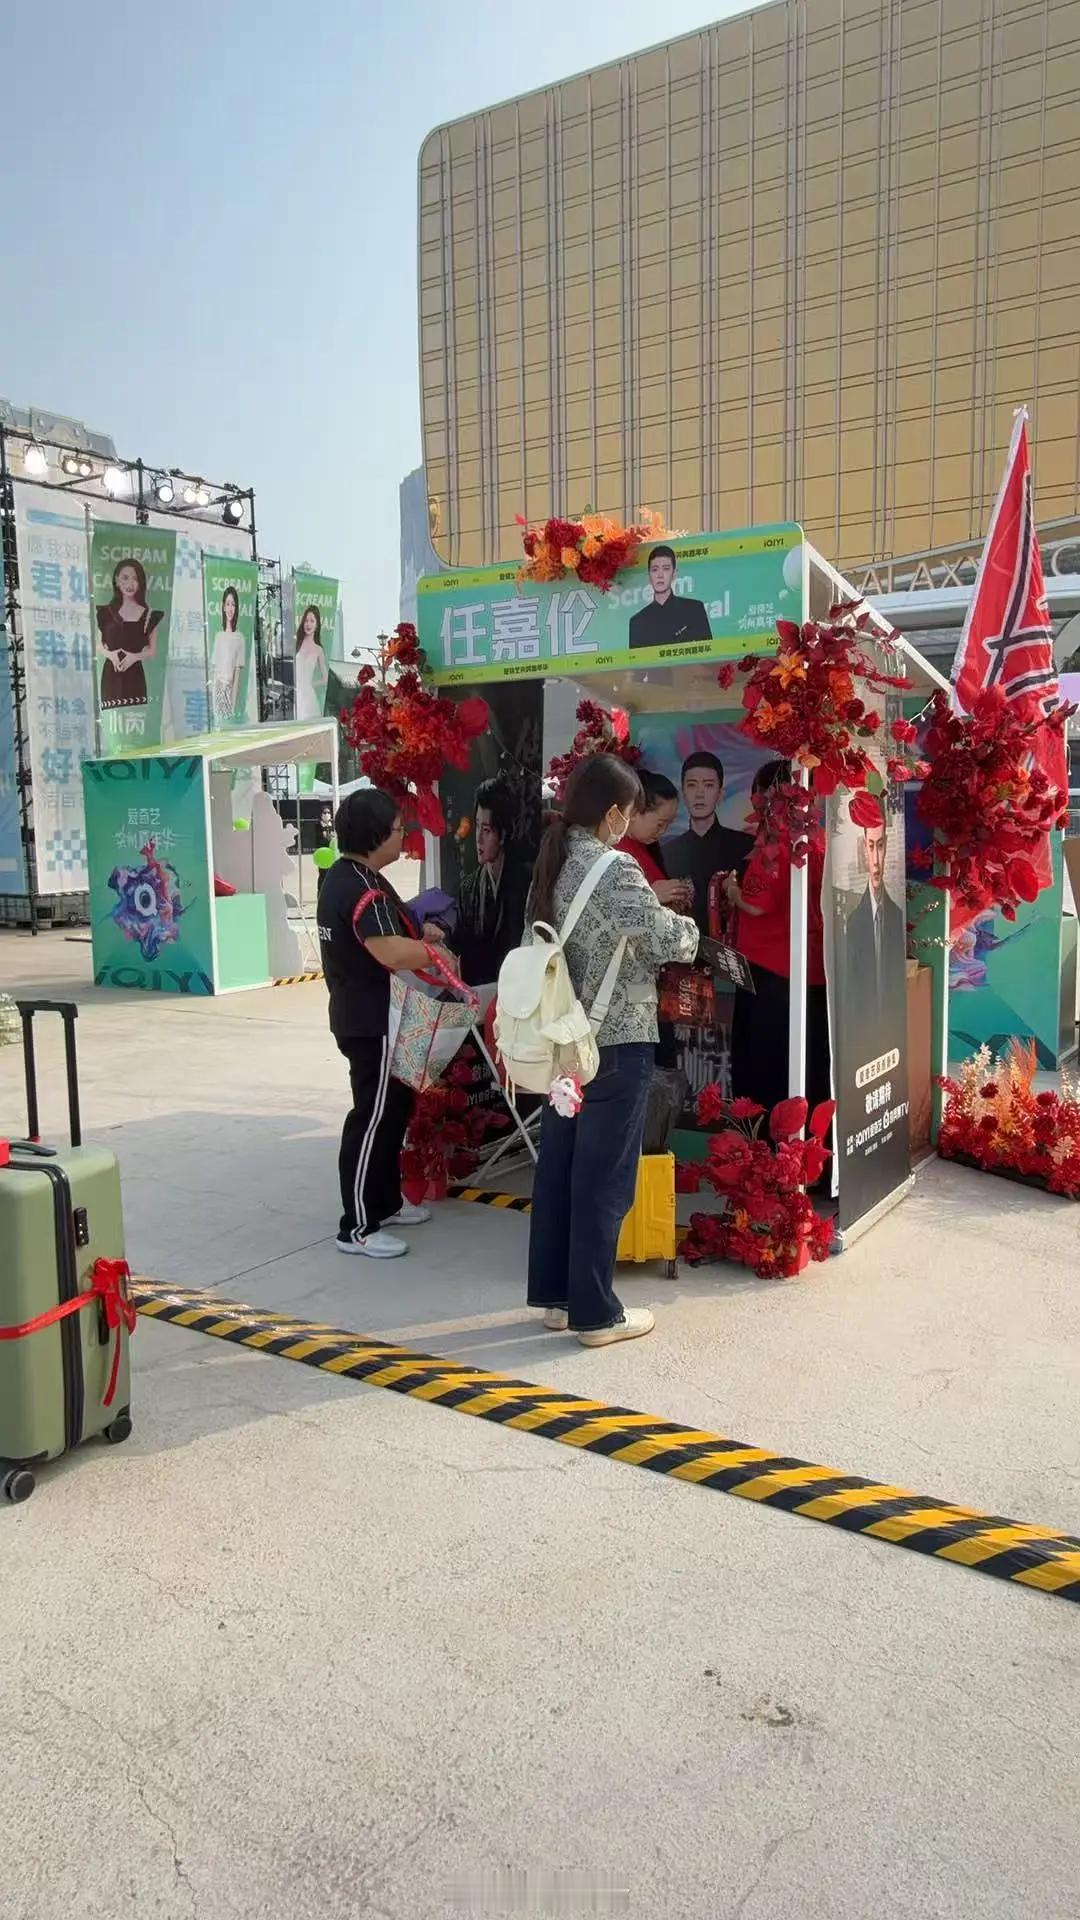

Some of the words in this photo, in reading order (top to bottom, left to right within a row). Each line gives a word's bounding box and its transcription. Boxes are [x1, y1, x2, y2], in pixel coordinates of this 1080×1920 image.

[763, 538, 784, 548] iQIYI
[100, 545, 168, 563] SCREAM
[93, 572, 173, 592] CAVAL
[211, 577, 252, 593] SCREAM
[296, 591, 333, 608] SCREAM
[607, 574, 694, 610] Screm
[207, 600, 254, 617] CAAL
[440, 588, 599, 667] 任嘉伦
[94, 965, 215, 997] iQIYI
